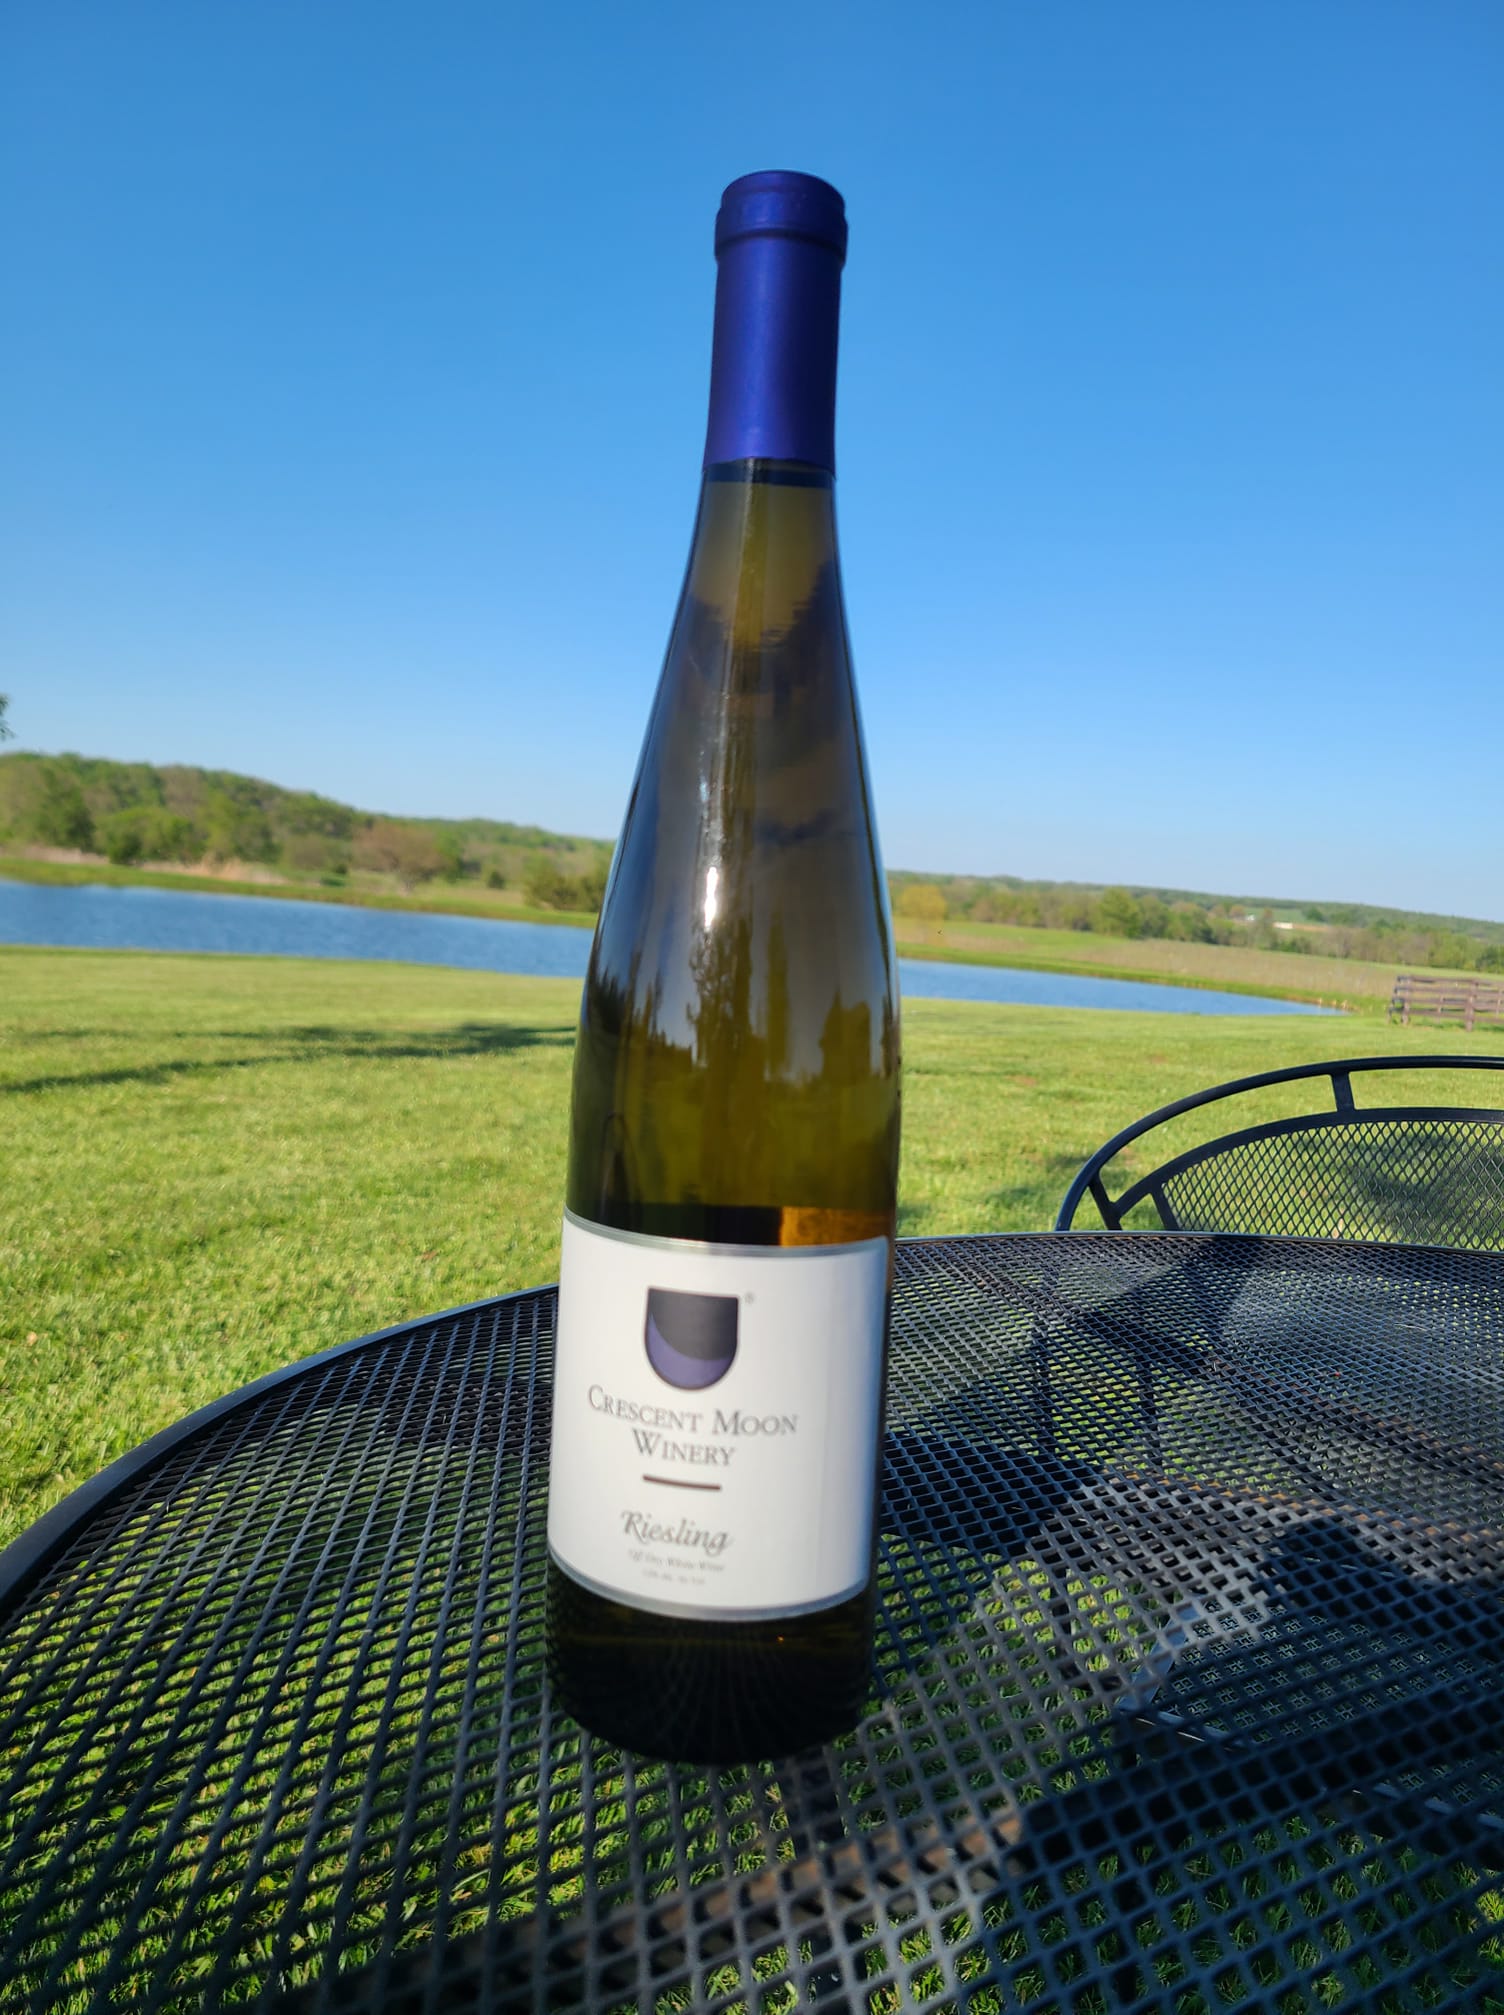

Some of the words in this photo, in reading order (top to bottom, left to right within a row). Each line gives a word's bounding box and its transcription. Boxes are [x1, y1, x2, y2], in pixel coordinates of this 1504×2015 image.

[588, 1384, 704, 1432] CRESCENT
[712, 1408, 798, 1436] MOON
[631, 1427, 735, 1466] WINERY
[621, 1510, 730, 1556] Riesling
